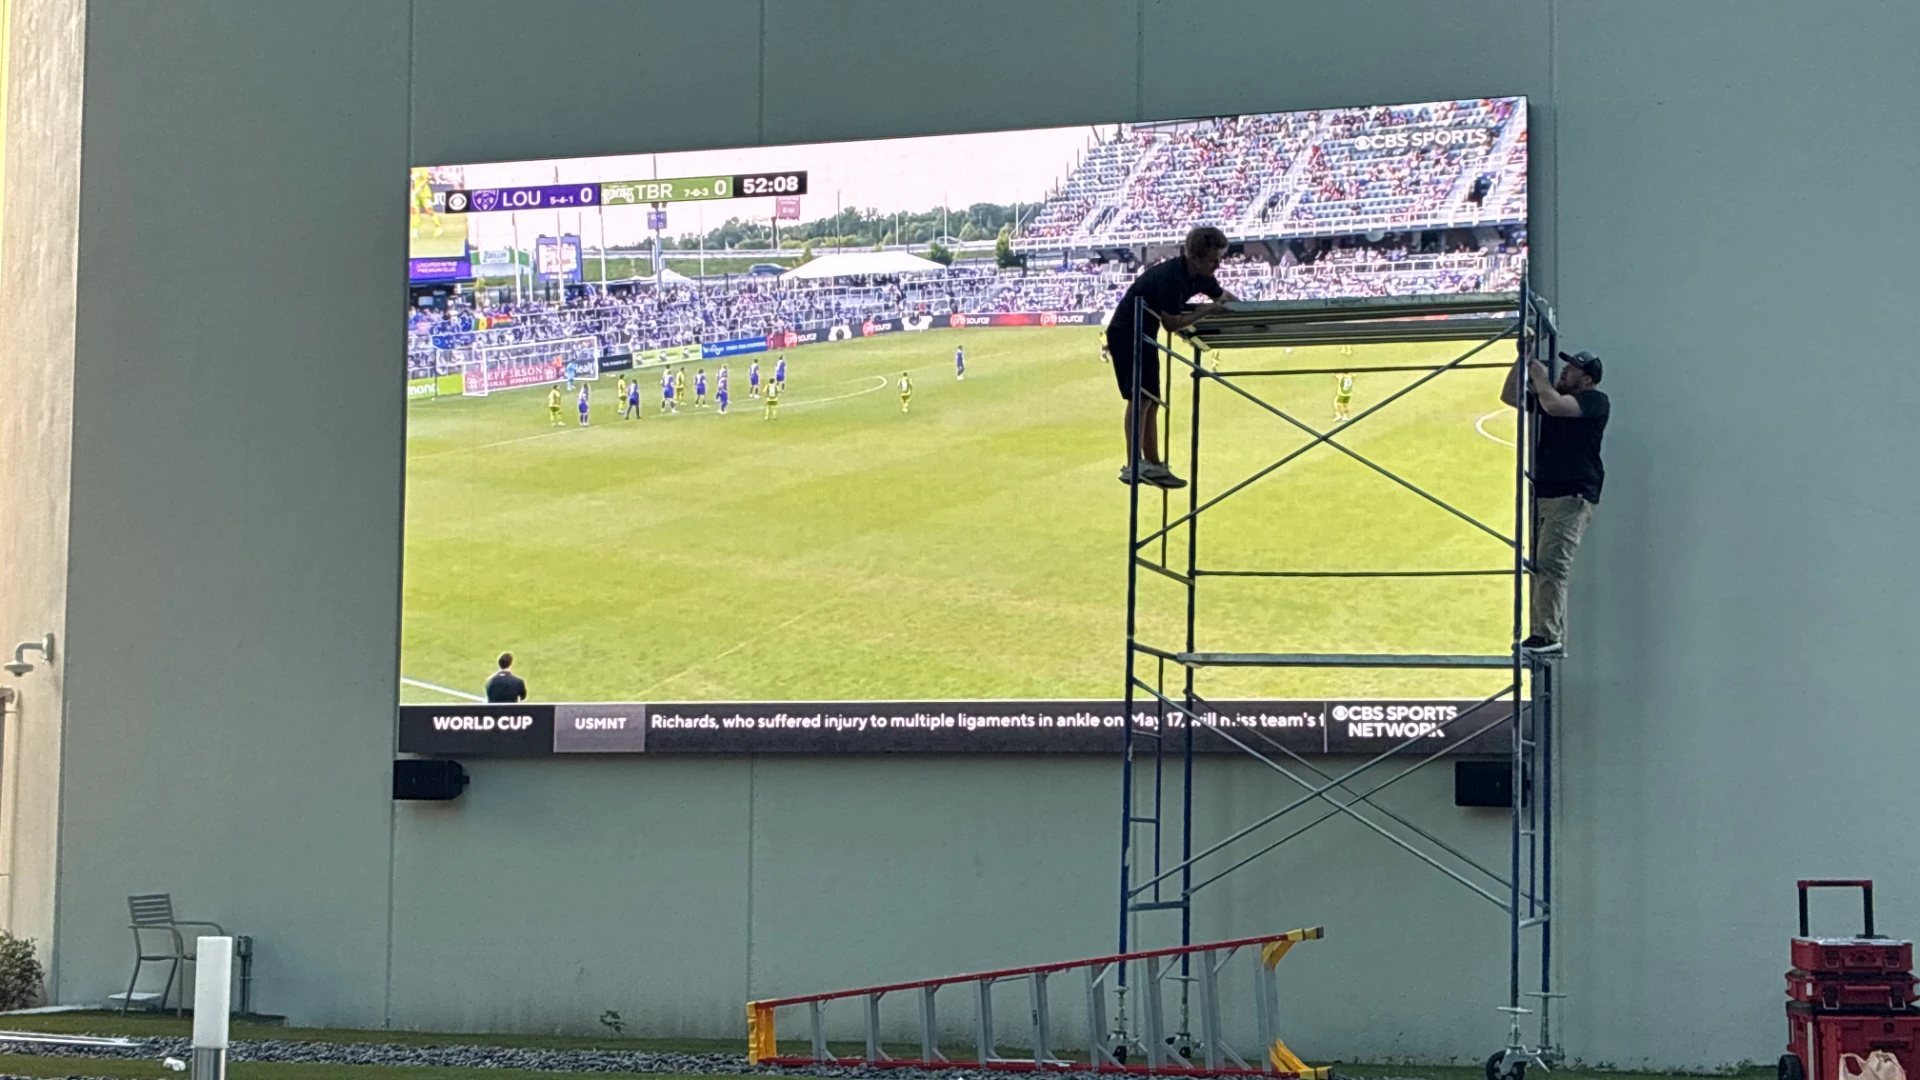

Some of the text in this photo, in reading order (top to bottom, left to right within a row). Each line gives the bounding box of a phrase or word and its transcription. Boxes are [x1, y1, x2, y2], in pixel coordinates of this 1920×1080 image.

[1371, 128, 1487, 149] CBS SPORTS
[502, 190, 541, 207] LOU
[580, 187, 592, 203] 0
[634, 183, 673, 199] TBR
[714, 180, 727, 195] 0
[743, 175, 799, 194] 52:08
[651, 714, 719, 730] Richards,
[722, 714, 754, 728] who
[757, 713, 821, 728] suffered
[824, 713, 866, 731] injury
[870, 714, 887, 728] to
[890, 713, 955, 731] multiple
[958, 712, 1035, 731] ligaments
[1038, 712, 1053, 727] in
[1056, 712, 1100, 727] ankle
[1103, 716, 1124, 727] on
[1131, 713, 1159, 730] May
[1166, 712, 1185, 728] 17,
[1259, 712, 1316, 727] team's
[1348, 706, 1458, 721] CBS SPORTS
[432, 716, 533, 730] WORLD CUP
[575, 717, 627, 730] USMNT
